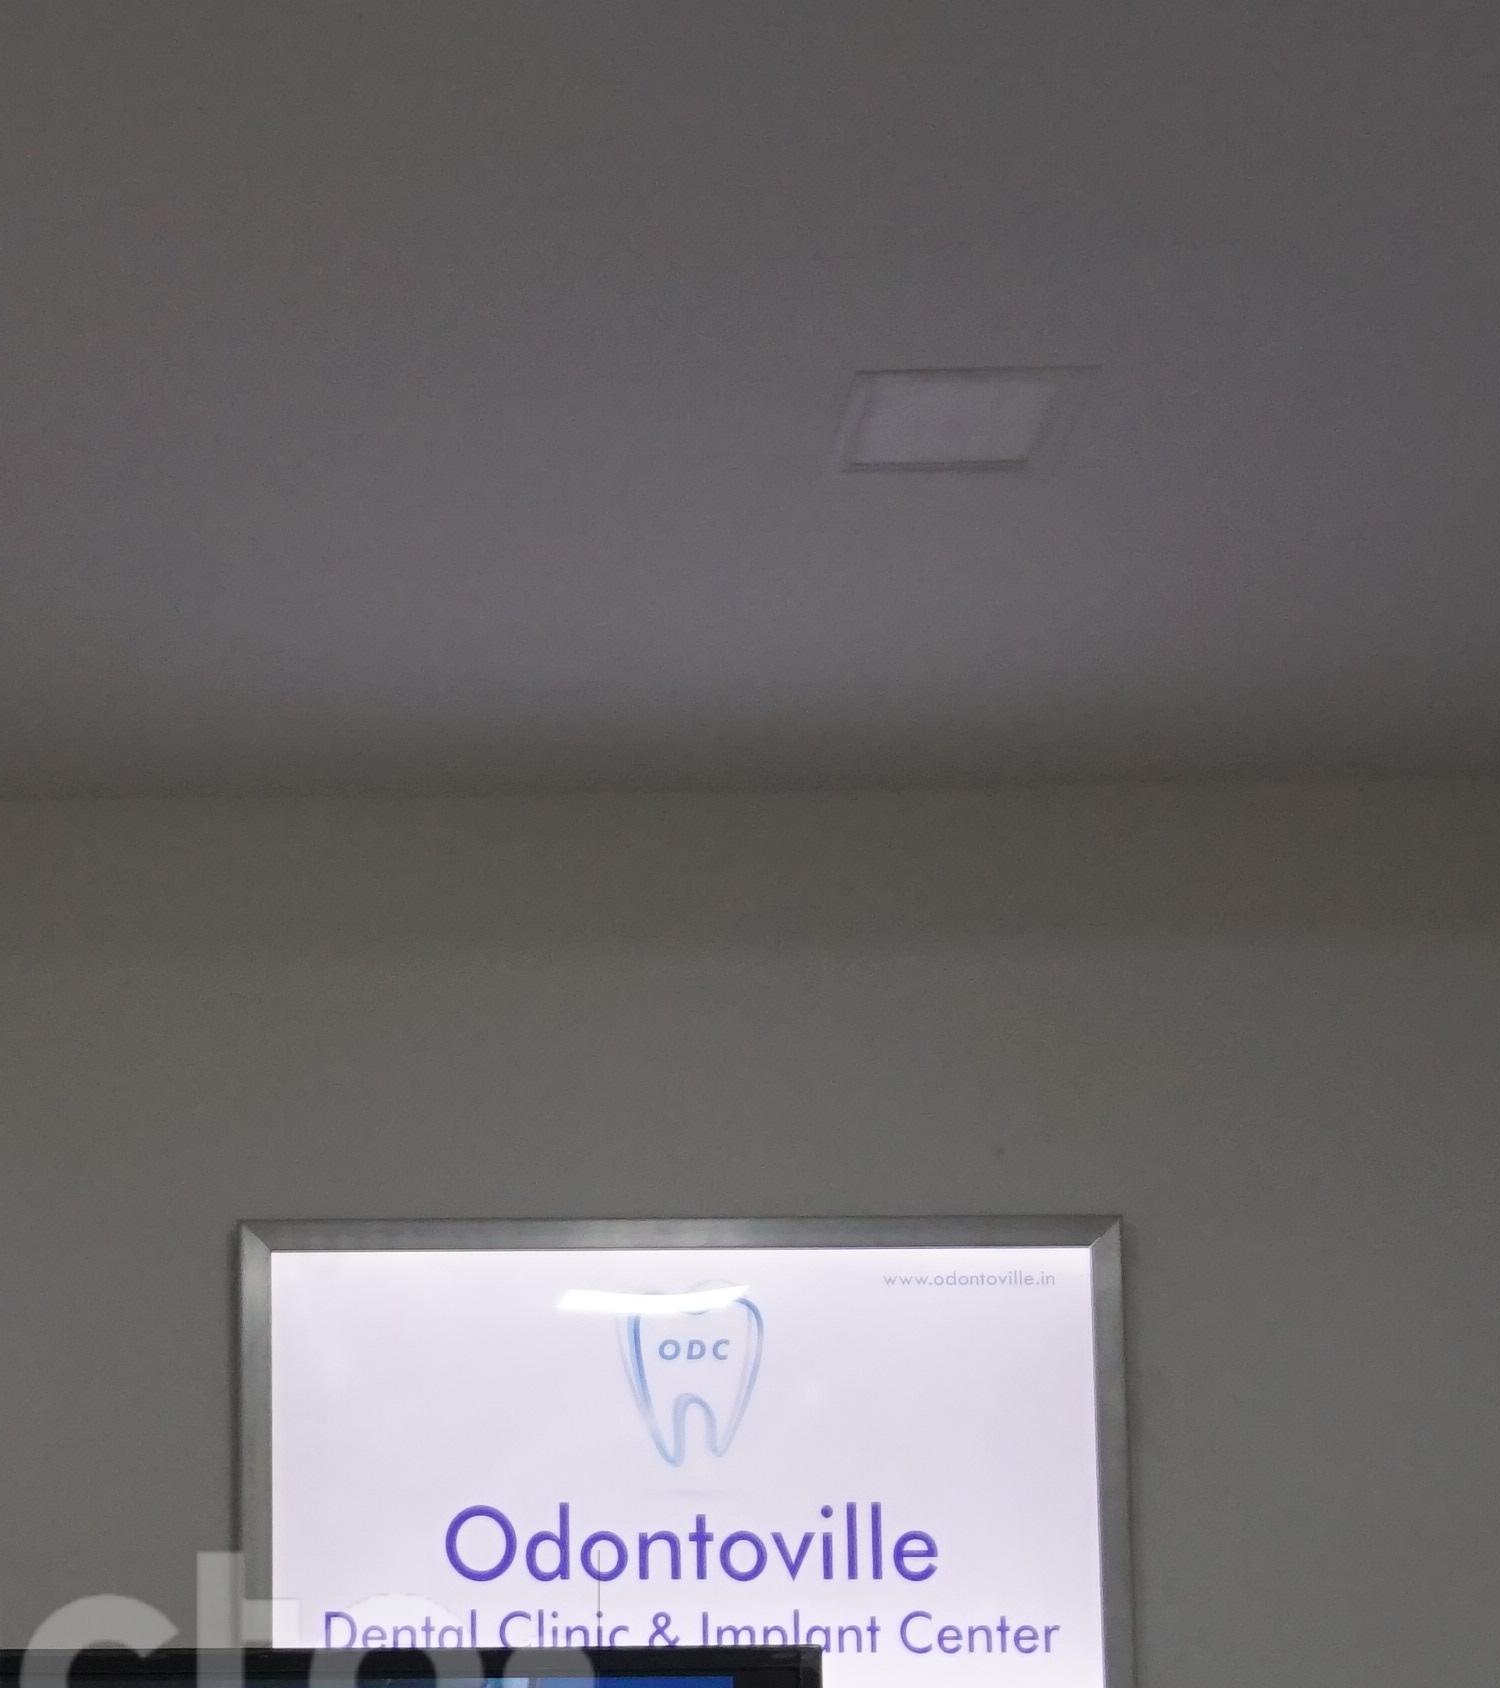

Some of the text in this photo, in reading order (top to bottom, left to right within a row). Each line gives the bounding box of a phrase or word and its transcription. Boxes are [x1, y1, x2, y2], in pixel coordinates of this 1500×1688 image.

[882, 1269, 1056, 1288] www.odontoville.in
[657, 1338, 730, 1361] ODC
[444, 1501, 939, 1585] Odontoville
[323, 1609, 1061, 1656] Dental Clinic & Implant Center
